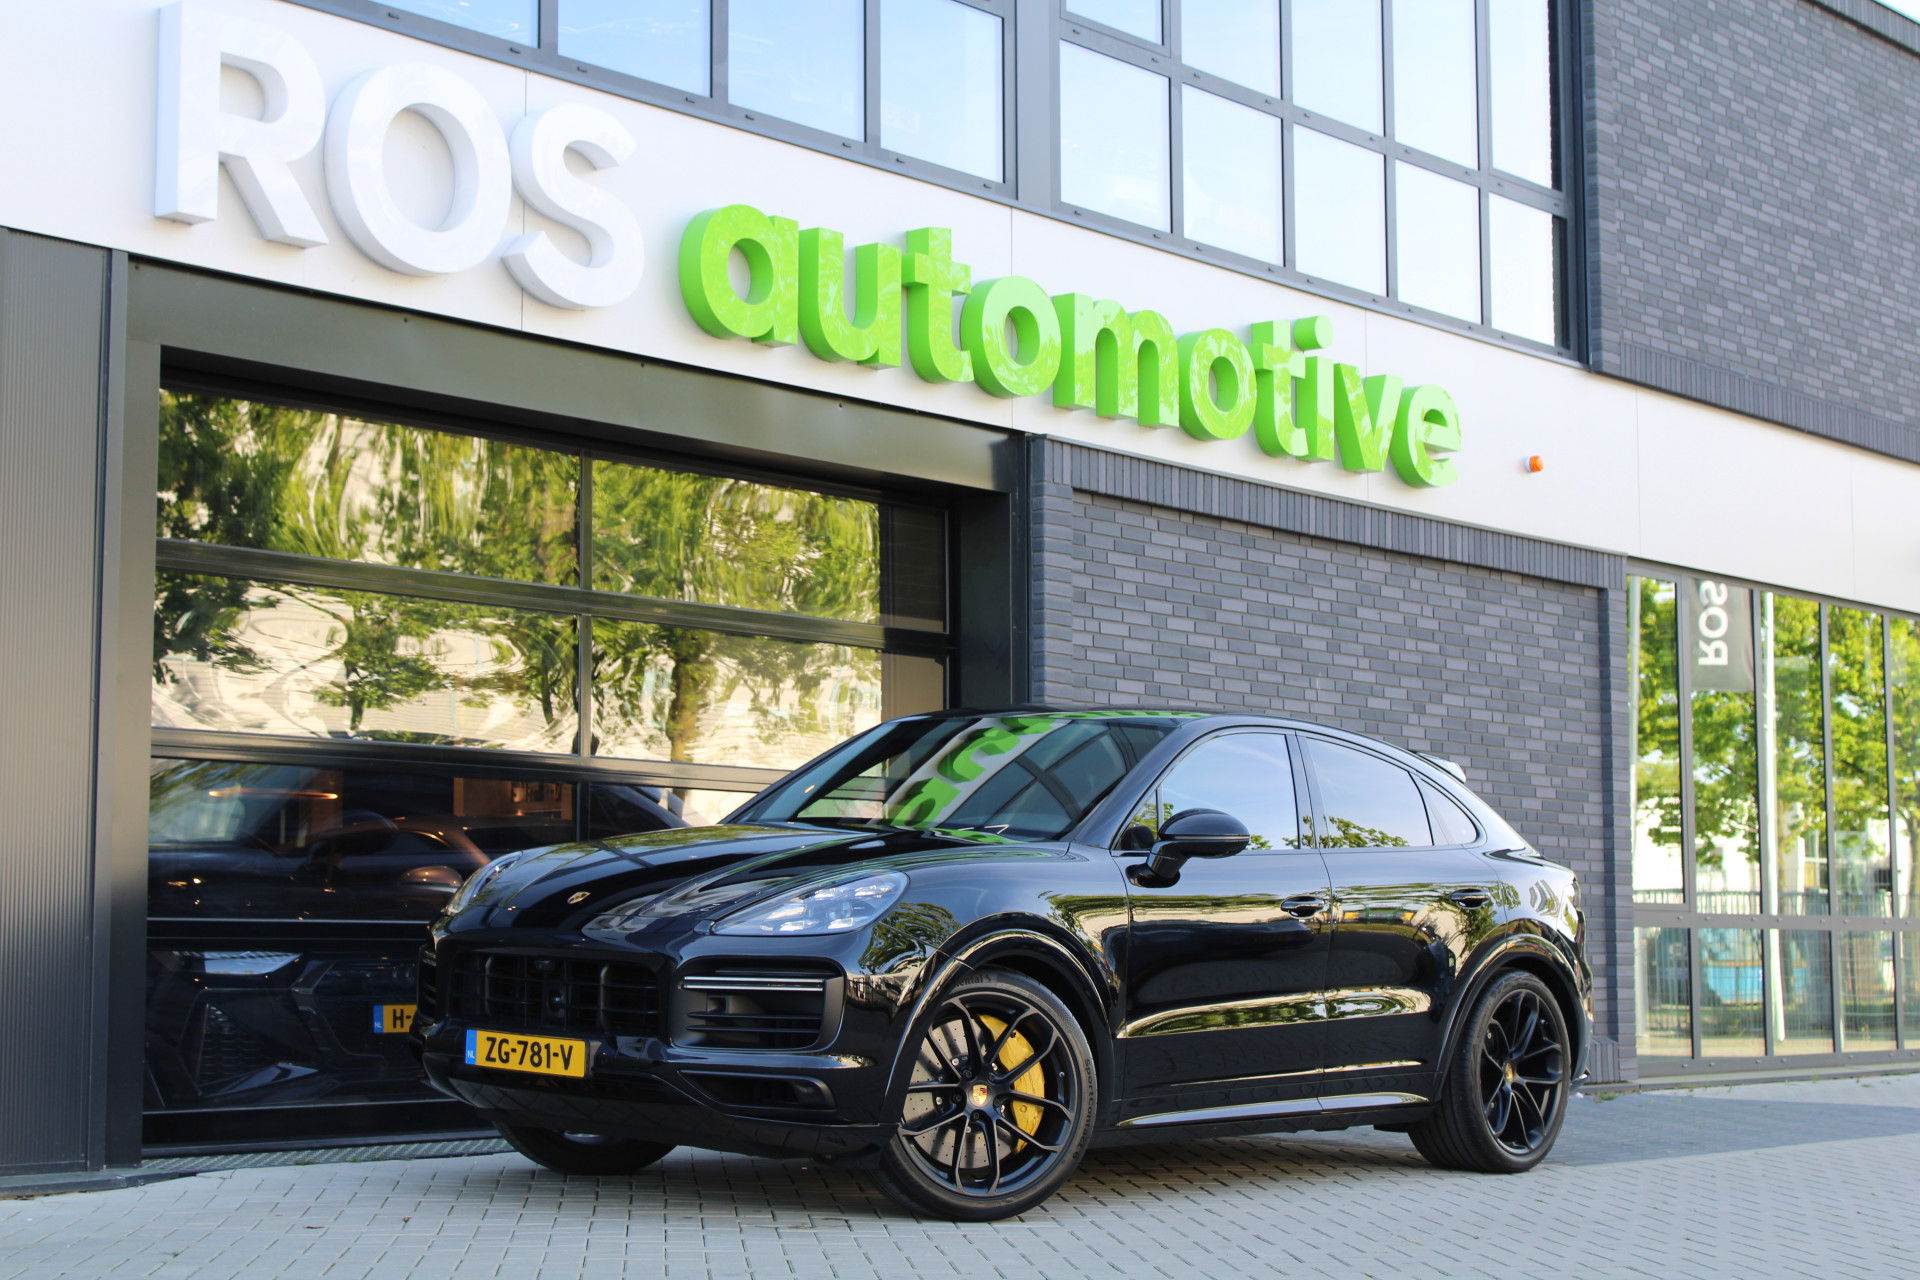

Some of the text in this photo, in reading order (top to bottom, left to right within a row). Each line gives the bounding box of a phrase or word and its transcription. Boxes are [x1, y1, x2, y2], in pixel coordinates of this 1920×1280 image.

[155, 1, 1462, 488] ROS automotive
[485, 1036, 574, 1071] ZG-781-V
